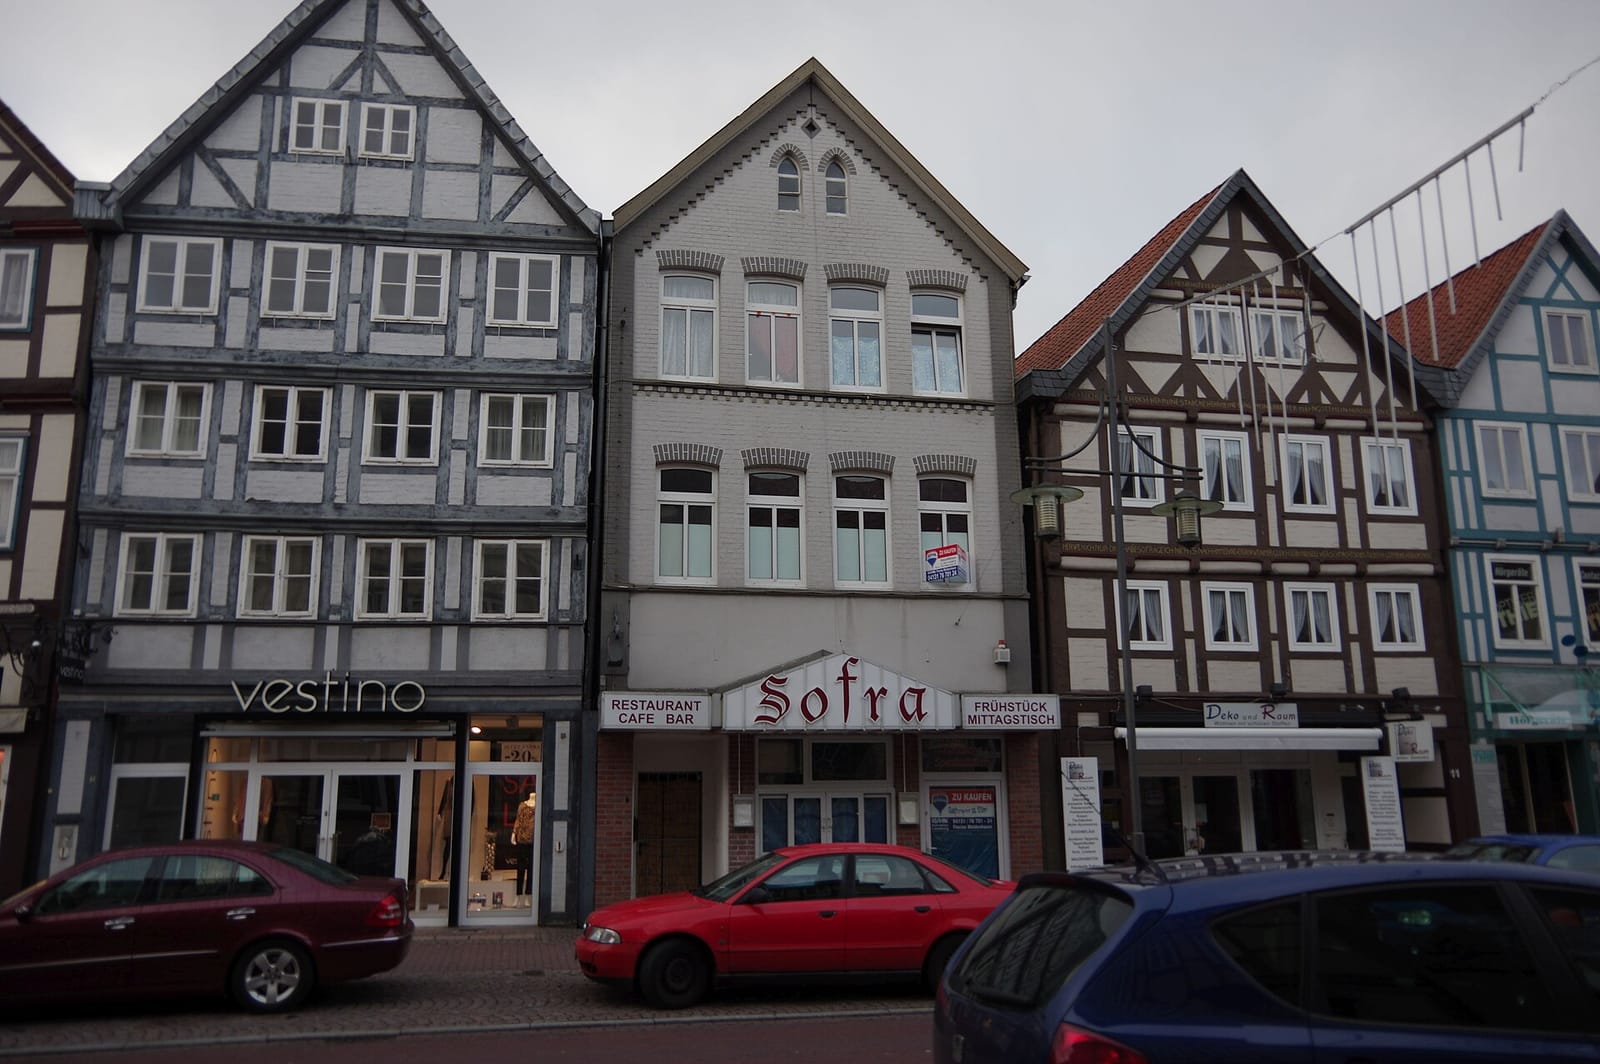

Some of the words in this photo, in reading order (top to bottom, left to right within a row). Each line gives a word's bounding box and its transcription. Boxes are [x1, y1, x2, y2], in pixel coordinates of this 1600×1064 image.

[231, 671, 426, 713] vestino
[754, 657, 928, 725] Sofra
[611, 700, 701, 711] RESTAURANT
[974, 700, 1047, 712] FRÜHSTÜCK
[1206, 704, 1239, 720] Deko
[1259, 704, 1296, 721] Raum
[618, 713, 655, 724] CAFE
[666, 714, 694, 724] BAR
[967, 714, 1055, 725] MITTAGSTISCH
[952, 793, 962, 801] ZU
[964, 793, 992, 801] KAUFEN
